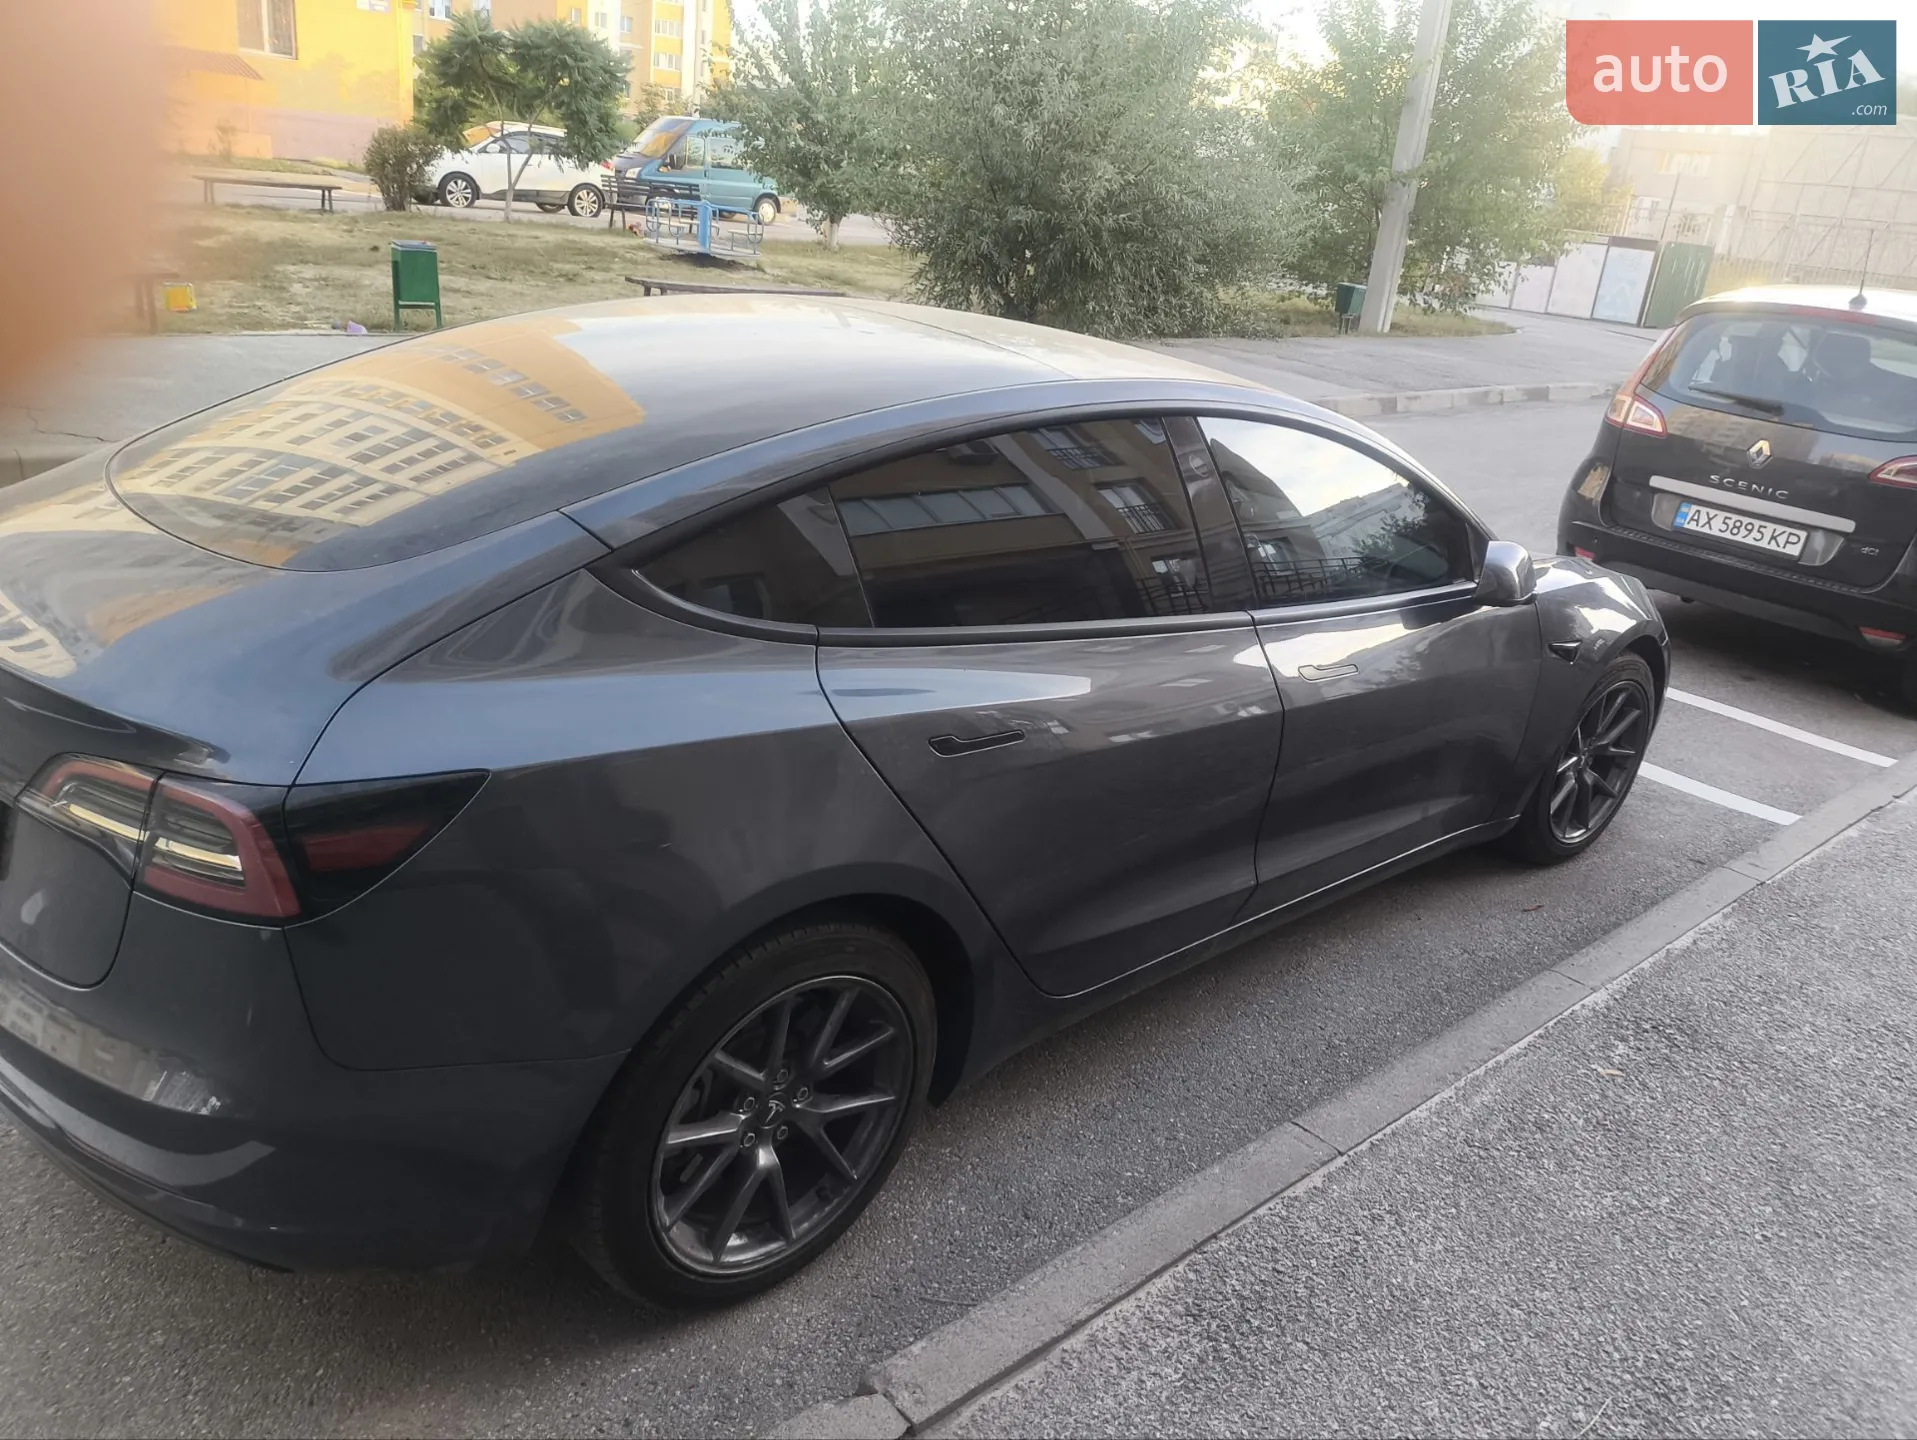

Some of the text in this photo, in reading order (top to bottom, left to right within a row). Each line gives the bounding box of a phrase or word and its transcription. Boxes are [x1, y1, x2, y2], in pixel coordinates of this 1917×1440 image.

[1709, 474, 1789, 499] SCENIC
[1687, 509, 1801, 549] AX 5895 KP
